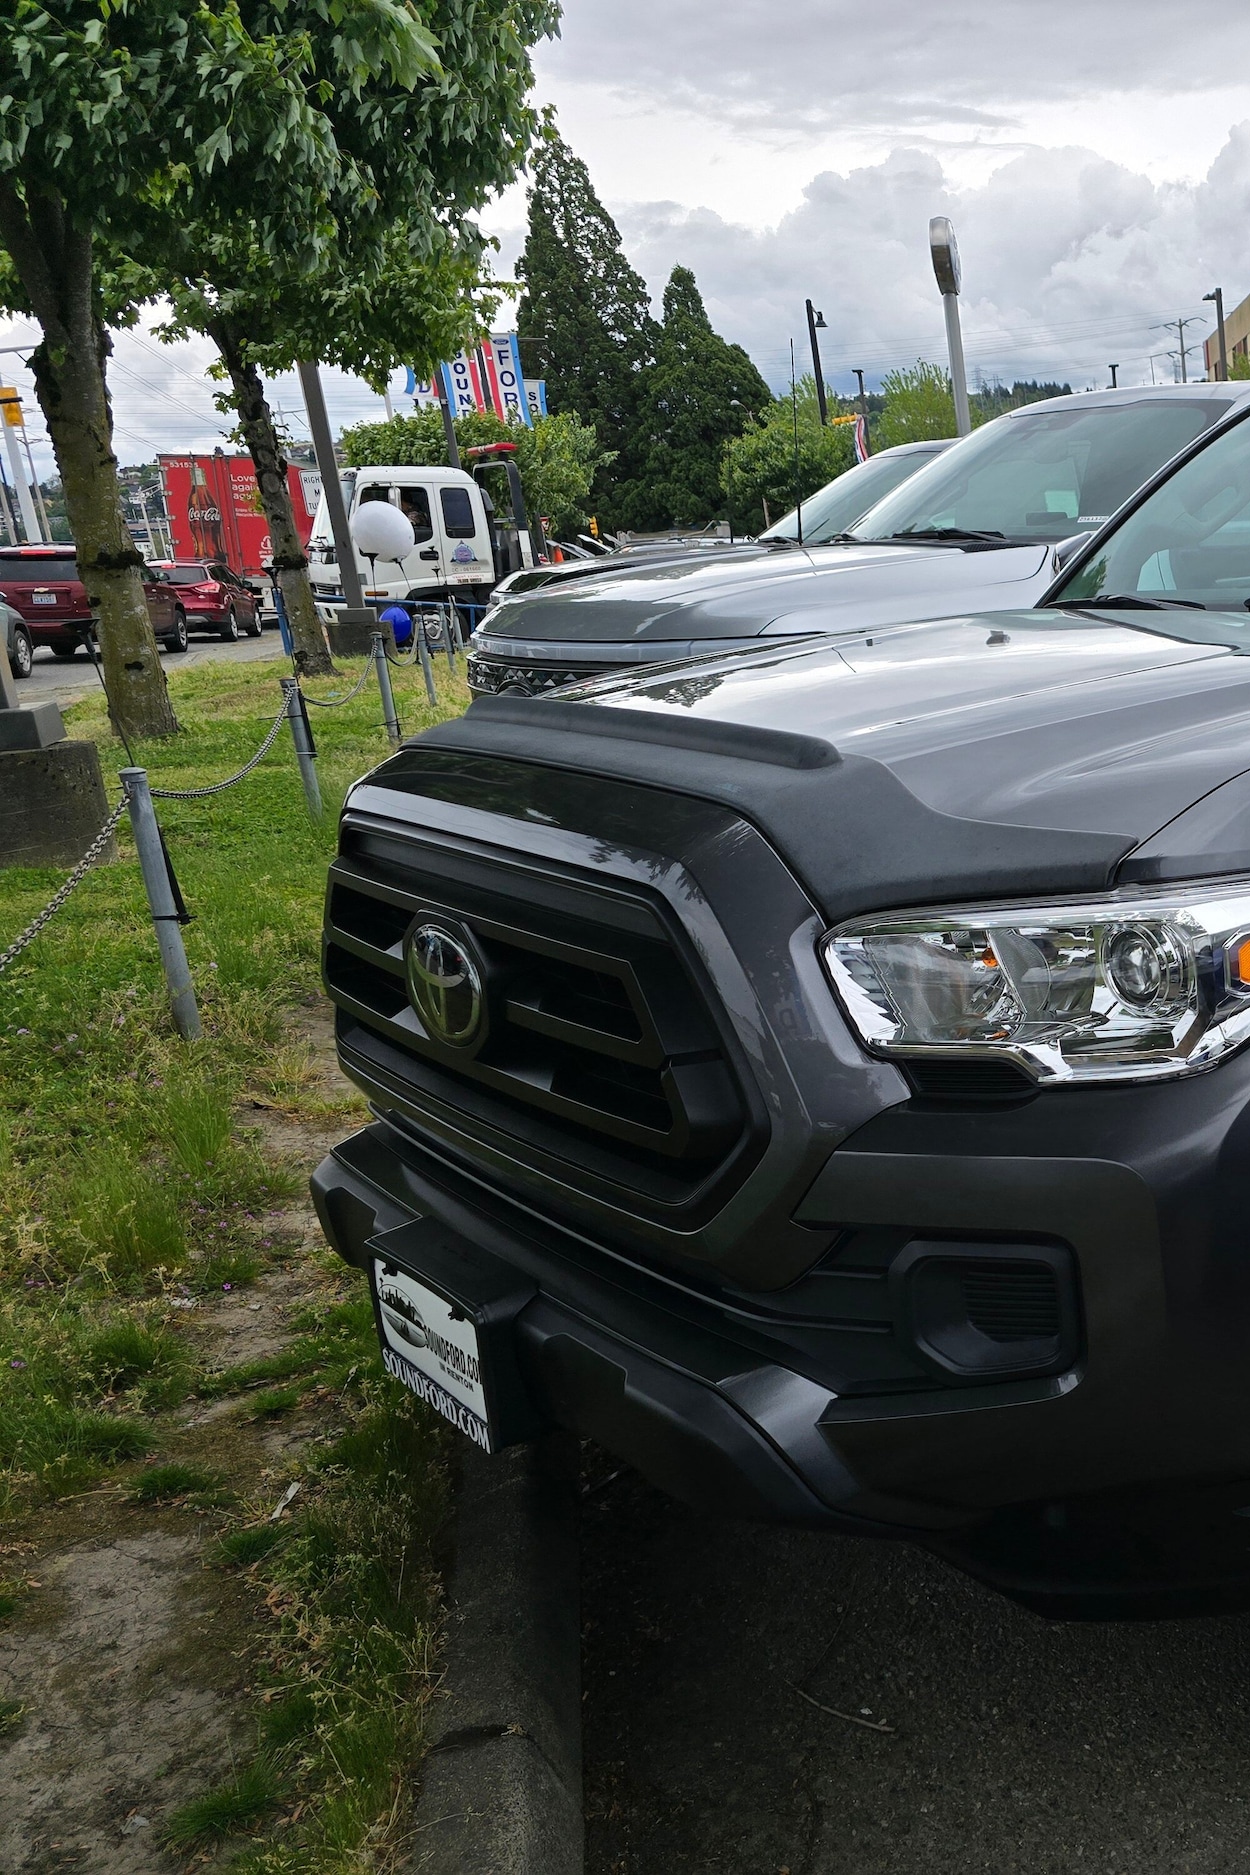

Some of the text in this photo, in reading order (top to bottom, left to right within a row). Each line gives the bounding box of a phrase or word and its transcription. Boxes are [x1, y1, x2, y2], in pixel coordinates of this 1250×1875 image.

[230, 473, 256, 483] Love
[303, 476, 321, 484] RIGH
[231, 483, 254, 492] agai
[381, 1347, 492, 1455] SOUNDFORD.COM
